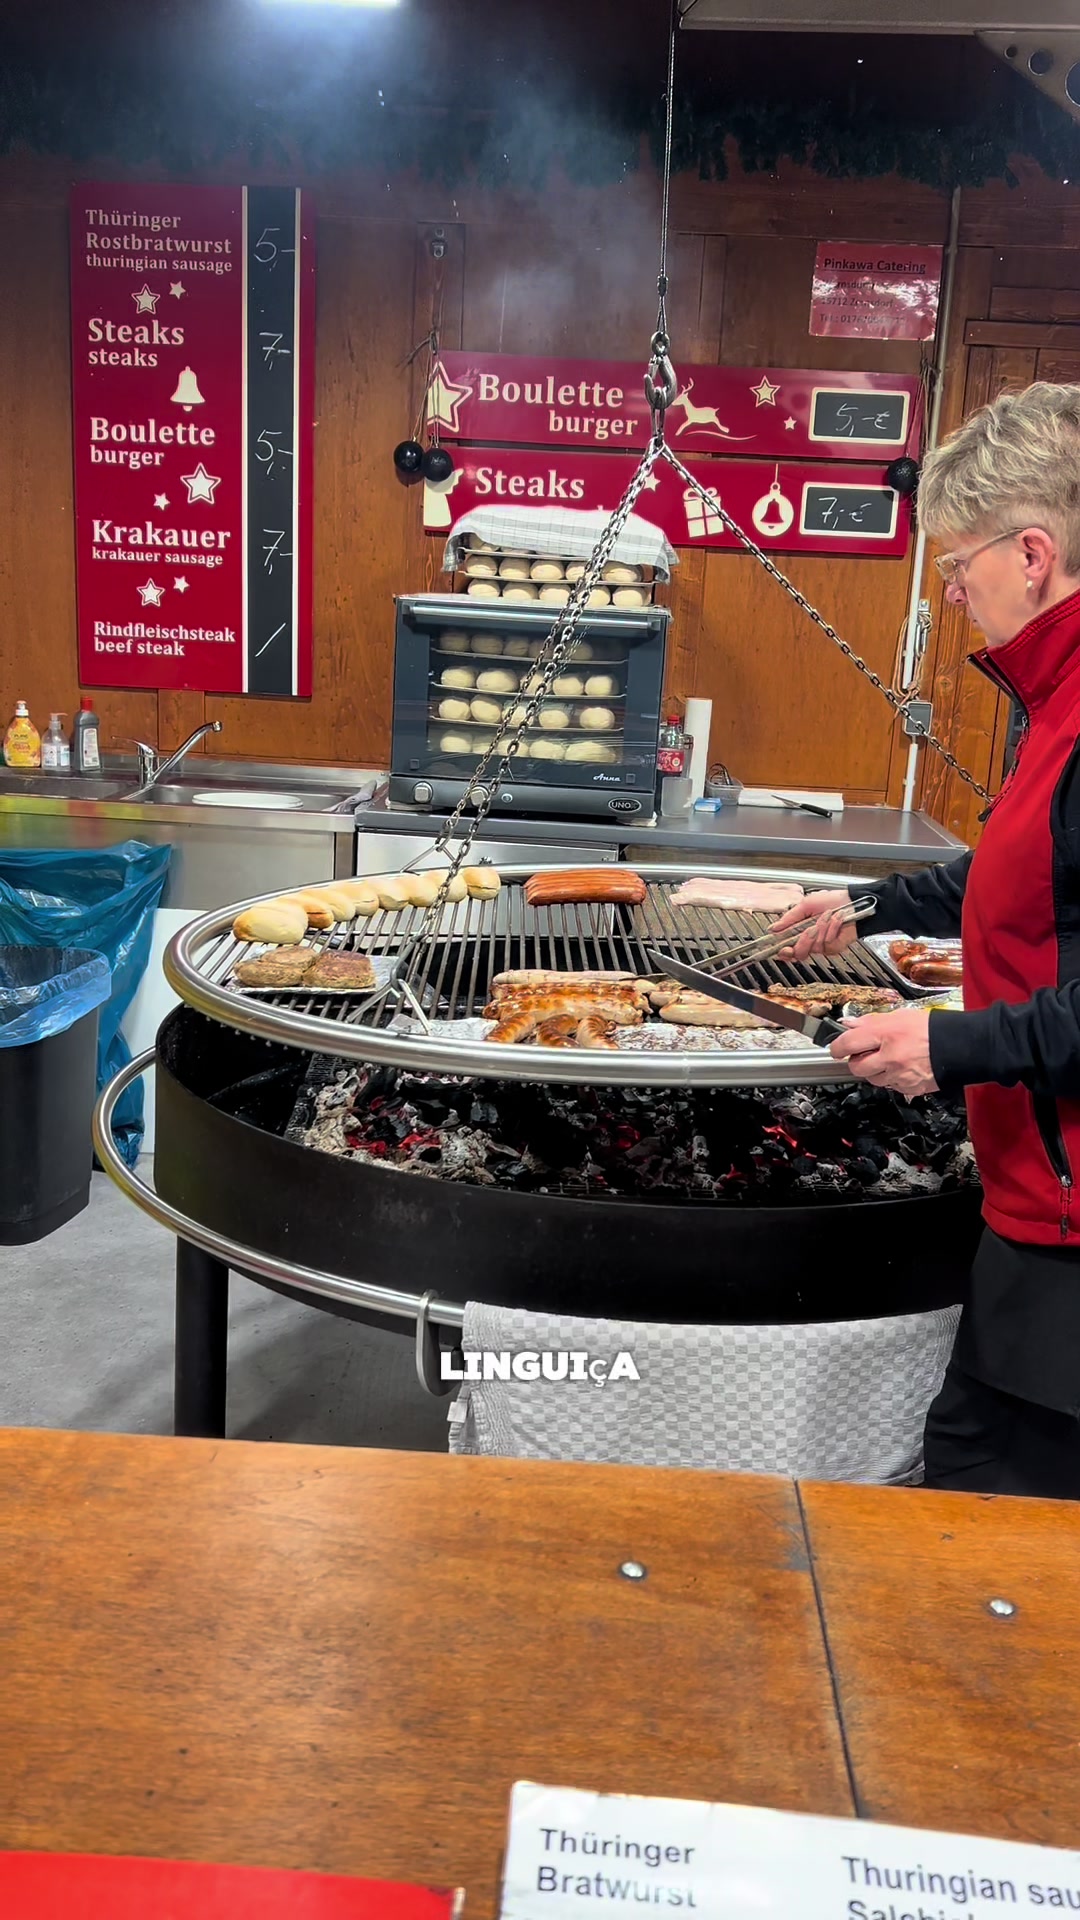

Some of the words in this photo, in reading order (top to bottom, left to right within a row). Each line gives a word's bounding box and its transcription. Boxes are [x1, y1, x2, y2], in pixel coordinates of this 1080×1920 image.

[85, 209, 181, 232] Thüringer
[85, 232, 232, 254] Rostbratwurst
[86, 254, 168, 272] thuringian
[171, 257, 232, 275] sausage
[824, 258, 873, 270] Pinkawa
[876, 260, 926, 274] Catering
[88, 318, 185, 345] Steaks
[88, 348, 158, 367] steaks
[478, 373, 624, 408] Boulette
[90, 416, 216, 446] Boulette
[549, 410, 638, 440] burger
[90, 445, 164, 469] burger
[475, 467, 585, 499] Steaks
[92, 519, 231, 549] Krakauer
[92, 546, 161, 563] krakauer
[164, 551, 223, 568] sausage
[94, 621, 236, 643] Rindfleischsteak
[94, 637, 133, 654] beef
[137, 640, 185, 656] steak
[593, 773, 621, 782] Anna
[539, 1828, 695, 1867] Thüringer
[537, 1865, 696, 1908] Bratwurst
[841, 1856, 1017, 1903] Thuringian
